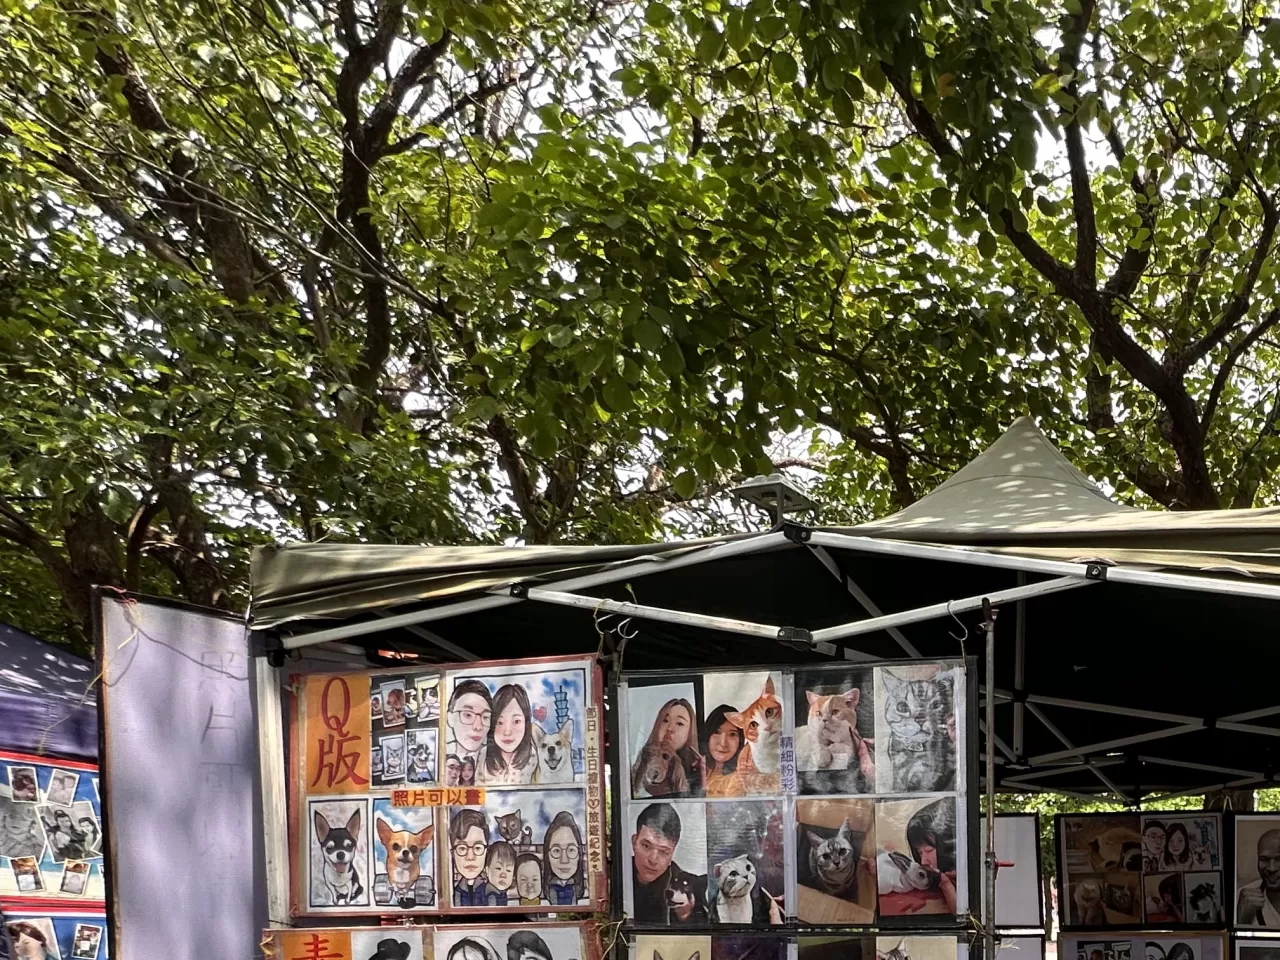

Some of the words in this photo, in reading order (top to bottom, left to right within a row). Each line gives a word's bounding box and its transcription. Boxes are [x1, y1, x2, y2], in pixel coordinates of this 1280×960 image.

[312, 677, 369, 788] Q版
[780, 736, 795, 791] 精細粉彩
[393, 789, 481, 806] 照片可以畫
